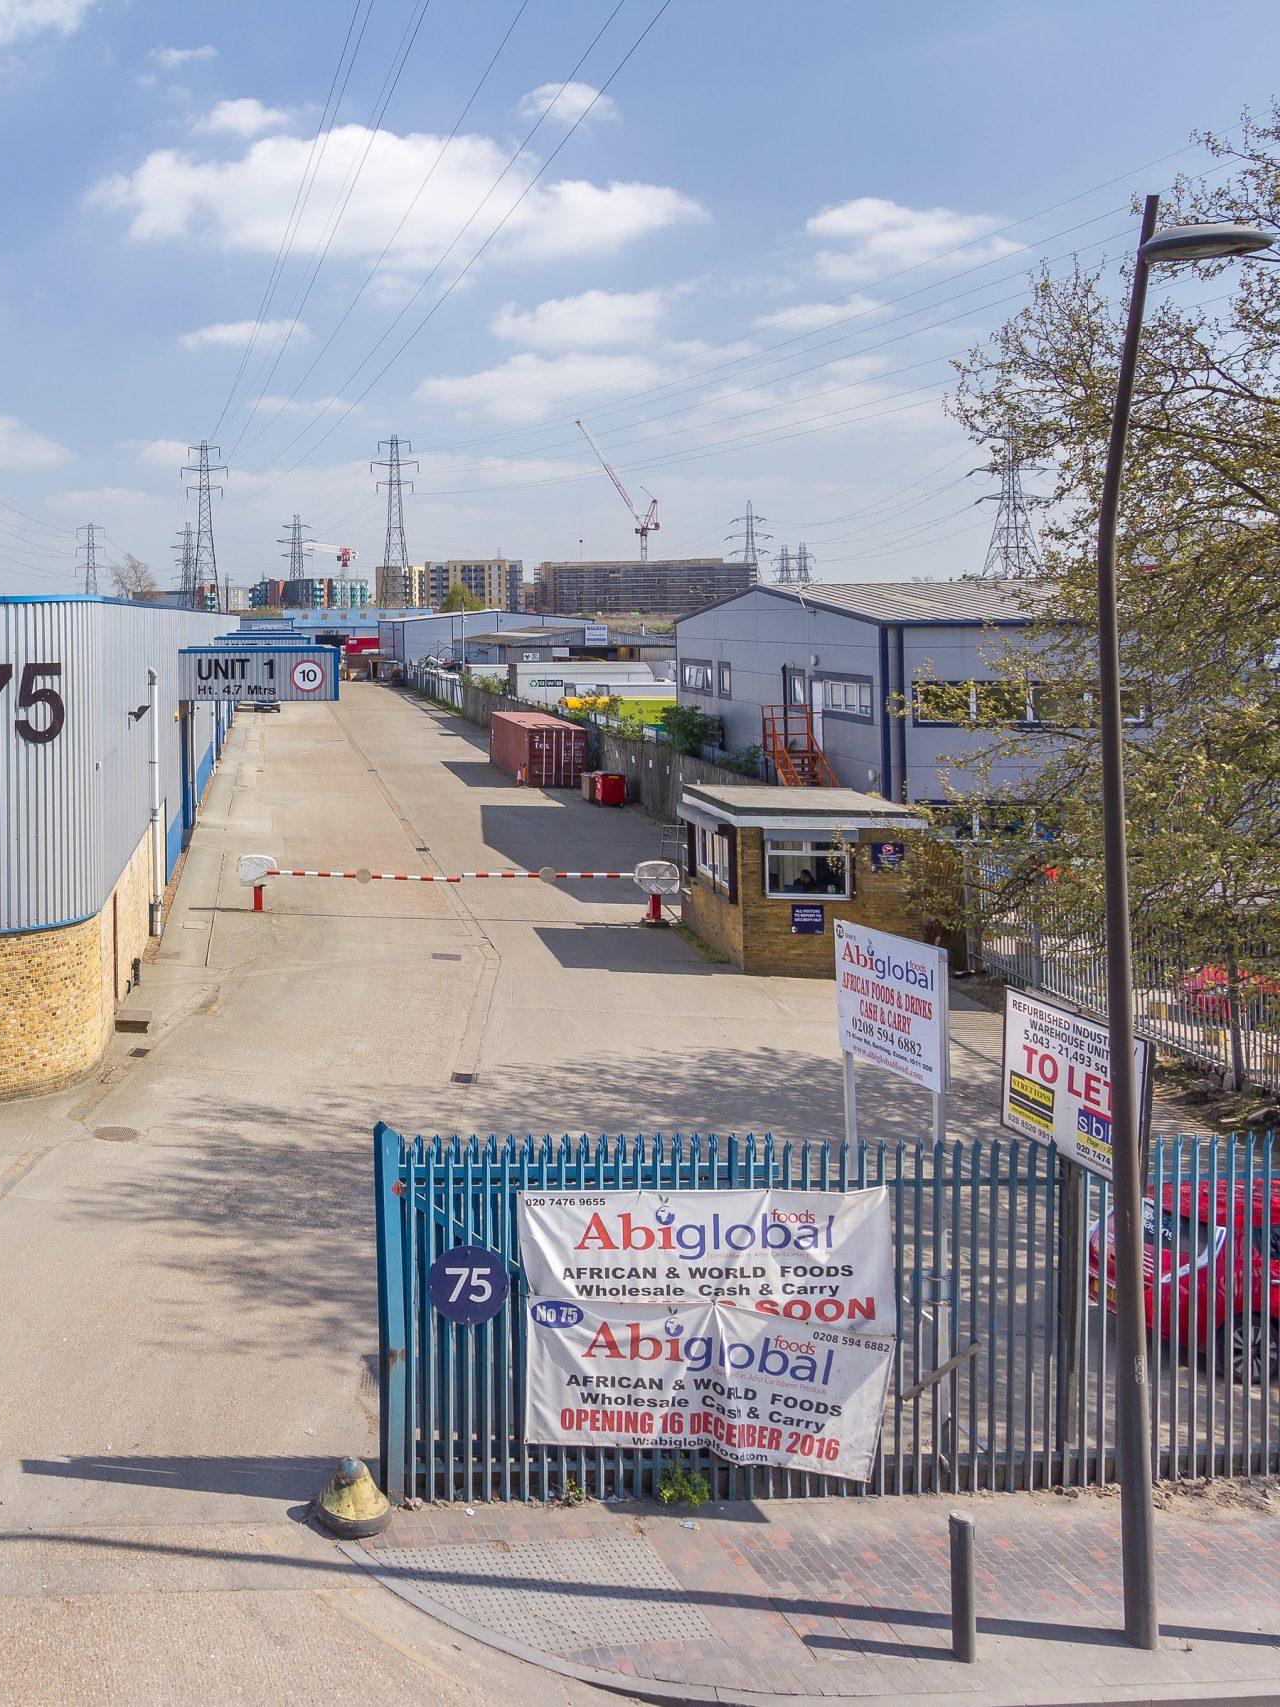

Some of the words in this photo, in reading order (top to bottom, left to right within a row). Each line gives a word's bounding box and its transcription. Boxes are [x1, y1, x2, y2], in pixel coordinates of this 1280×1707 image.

[197, 658, 250, 681] UNIT
[264, 658, 275, 680] 1
[299, 669, 317, 682] 10
[198, 685, 218, 696] Ht.
[223, 685, 242, 696] 4.7
[247, 685, 276, 696] Mtrs
[909, 960, 926, 973] foods
[842, 971, 869, 997] AFRICAN
[871, 982, 895, 1006] FOODS
[897, 991, 902, 1009] &
[905, 993, 933, 1020] DRINKS
[860, 999, 878, 1022] CASH
[880, 1007, 885, 1025] &
[887, 1010, 912, 1035] CARRY
[1012, 999, 1070, 1031] REFURBISHED
[1072, 1024, 1110, 1047] INDUST
[852, 1016, 874, 1037] 0208
[877, 1027, 894, 1046] 594
[897, 1036, 923, 1057] 6882
[1030, 1019, 1085, 1052] WAREHOUSE
[1087, 1043, 1110, 1061] UNIT
[852, 1044, 924, 1081] www.abiglobalfood.com
[1022, 1044, 1059, 1084] TO
[1024, 1029, 1050, 1048] 5,043
[1058, 1044, 1092, 1068] 21,493
[1094, 1062, 1108, 1078] sq
[1012, 1079, 1051, 1102] STRETTONS
[1008, 1113, 1019, 1125] 020
[1021, 1120, 1036, 1133] 8520
[1076, 1142, 1090, 1155] 020
[1092, 1149, 1111, 1165] 7474
[525, 1198, 545, 1207] 020
[549, 1198, 575, 1206] 7476
[579, 1198, 606, 1206] 9655
[770, 1208, 816, 1224] foods
[574, 1207, 835, 1260] Abiglobal
[562, 1266, 657, 1280] AFRICAN
[665, 1266, 680, 1279] &
[688, 1266, 766, 1280] WORLD
[780, 1264, 854, 1278] FOODS
[444, 1267, 492, 1303] 75
[575, 1284, 685, 1297] Wholesale
[698, 1283, 750, 1297] Cash
[759, 1283, 773, 1296] &
[781, 1282, 840, 1297] Carry
[536, 1305, 556, 1321] No
[560, 1305, 578, 1323] 75
[755, 1296, 876, 1322] SOON
[774, 1335, 816, 1355] foods
[813, 1331, 838, 1344] 0208
[841, 1336, 861, 1347] 594
[864, 1341, 890, 1353] 6882
[566, 1374, 663, 1391] AFRICAN
[672, 1379, 686, 1391] &
[693, 1378, 757, 1400] WORLD
[770, 1393, 842, 1417] FOODS
[580, 1392, 689, 1408] Wholesale
[701, 1395, 741, 1419] Cash
[746, 1406, 760, 1419] &
[768, 1411, 826, 1434] Carry
[560, 1408, 654, 1434] OPENING
[659, 1411, 684, 1435] 16
[690, 1411, 783, 1451] DECEMBER
[785, 1431, 840, 1461] 2016
